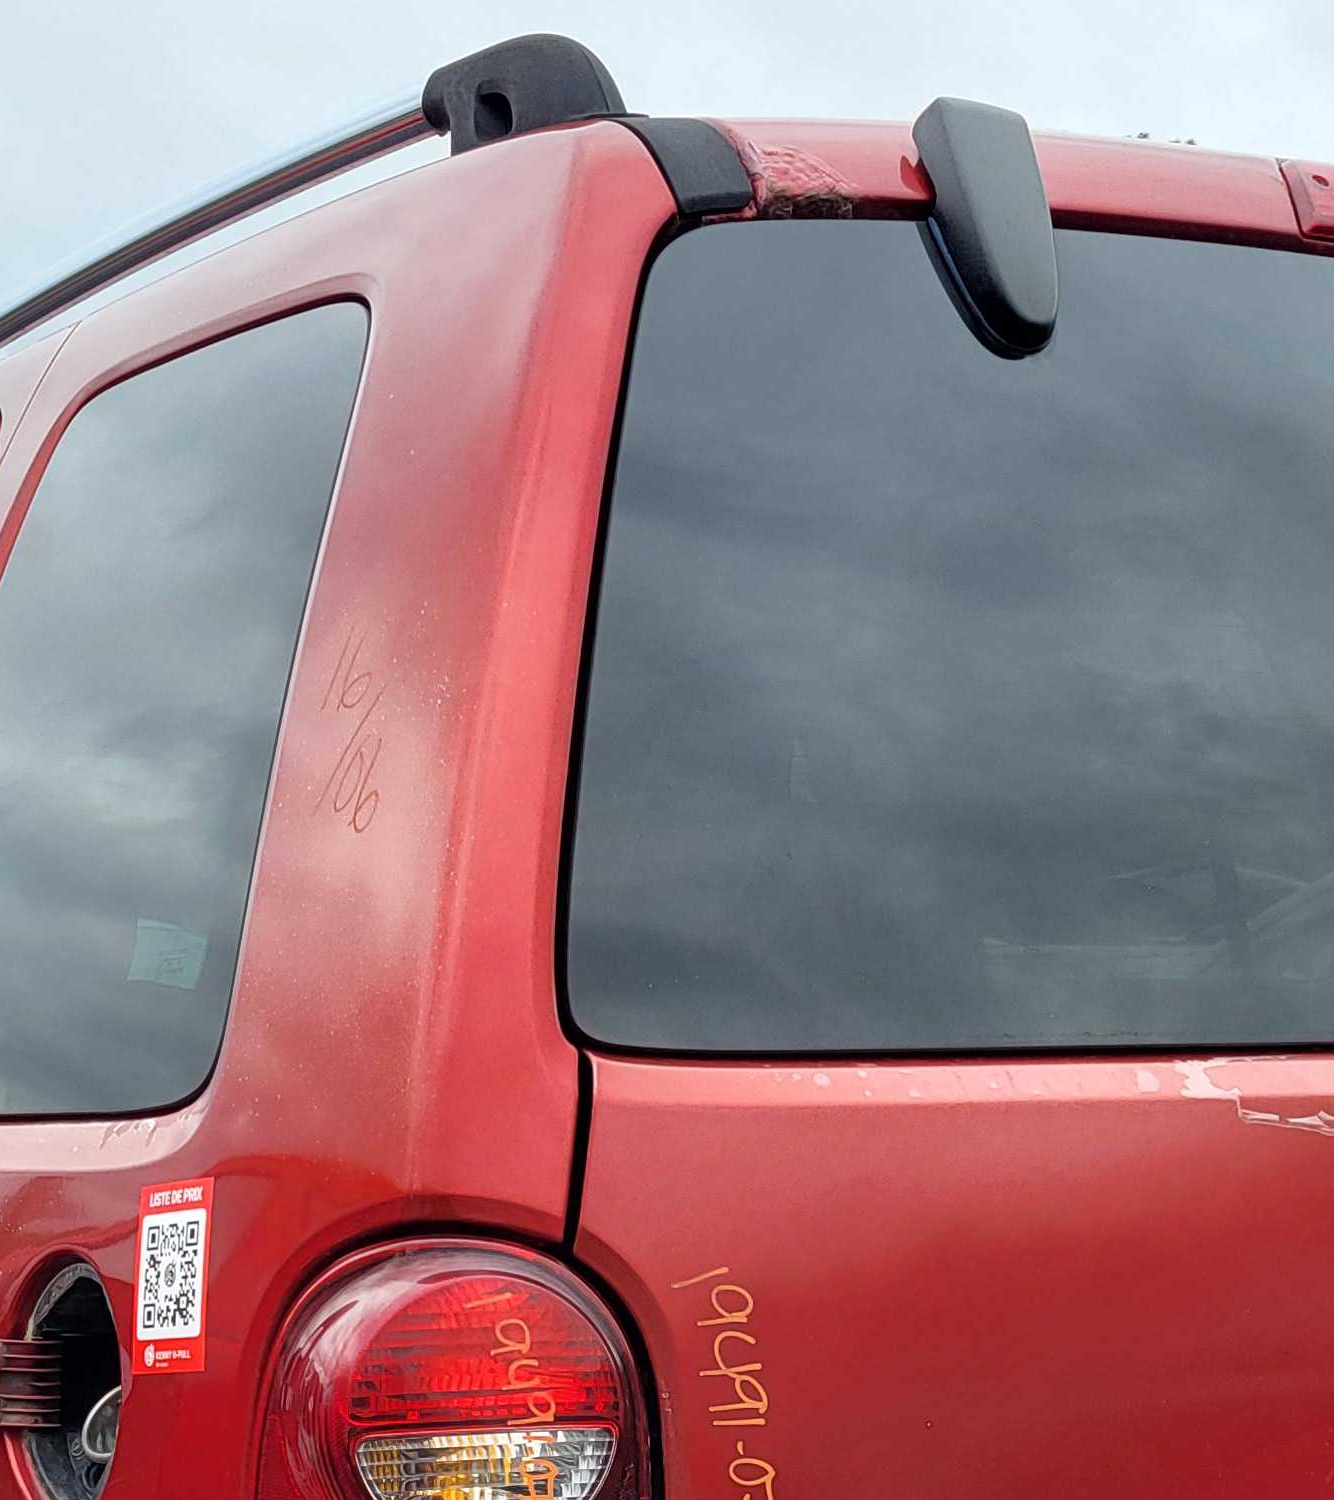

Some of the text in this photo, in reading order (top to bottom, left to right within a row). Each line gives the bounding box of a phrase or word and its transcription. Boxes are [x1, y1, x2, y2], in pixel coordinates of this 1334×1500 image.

[149, 1185, 204, 1208] LISTE DE PRIX
